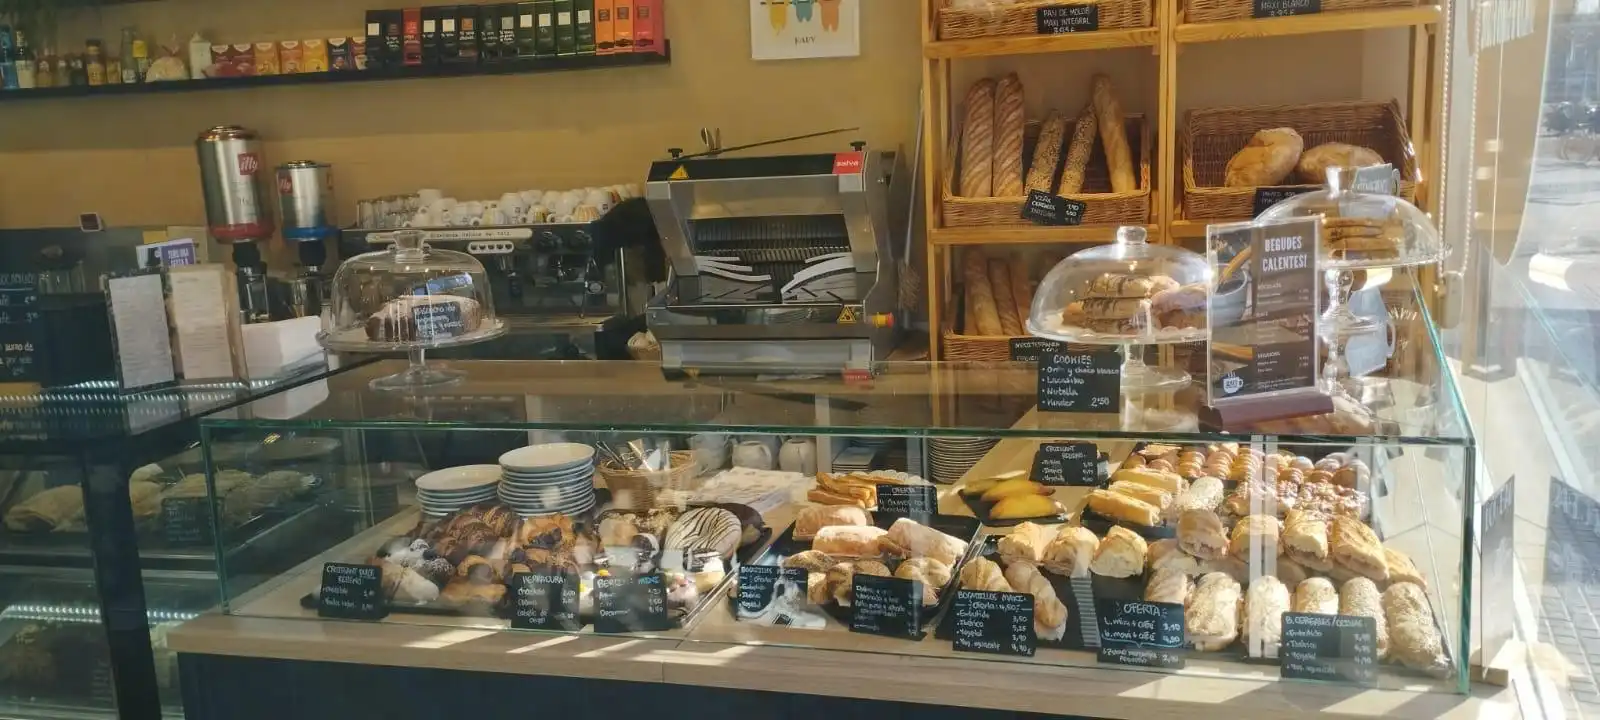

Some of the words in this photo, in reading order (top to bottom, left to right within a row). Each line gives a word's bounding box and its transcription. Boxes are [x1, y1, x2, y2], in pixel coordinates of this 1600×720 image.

[836, 160, 859, 168] salva
[1264, 236, 1303, 253] BEGUDES
[1123, 602, 1161, 616] OFERTA
